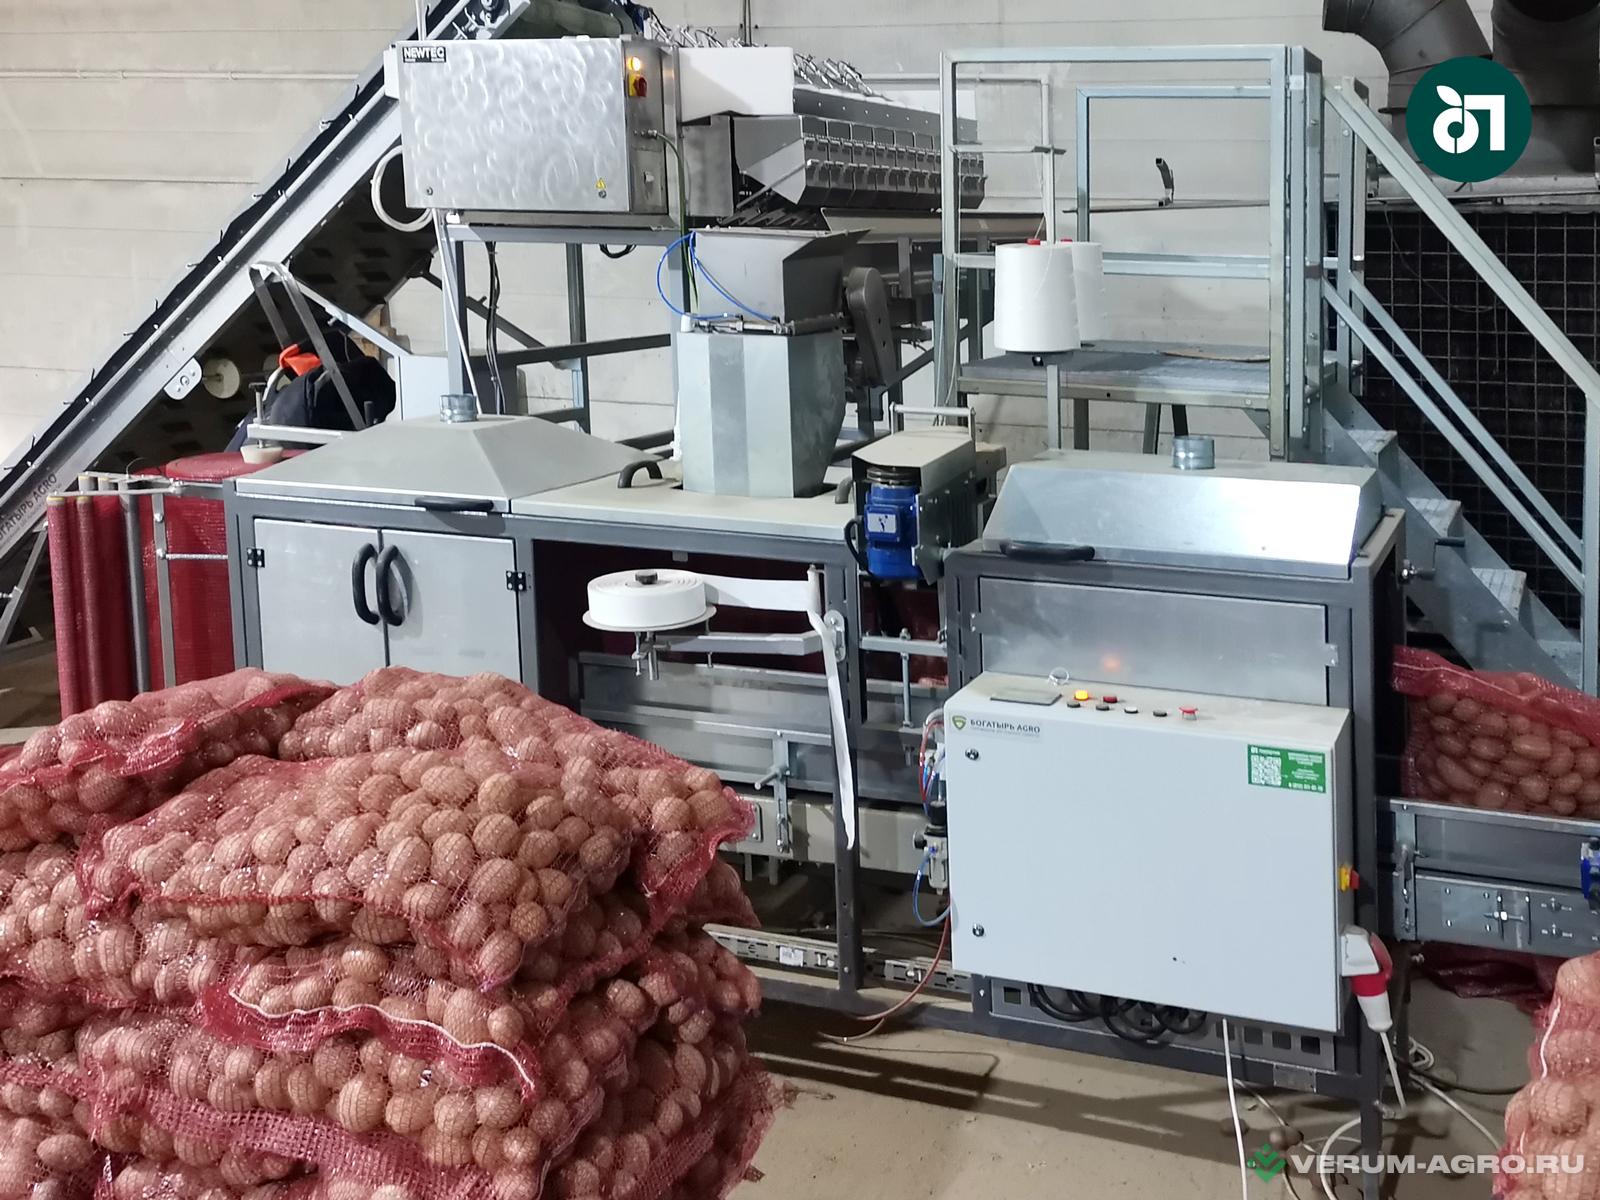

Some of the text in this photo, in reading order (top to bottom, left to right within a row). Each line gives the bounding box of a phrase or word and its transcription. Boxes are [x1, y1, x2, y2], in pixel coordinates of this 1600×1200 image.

[403, 46, 445, 59] NEWTEC
[33, 474, 57, 501] AGRO
[970, 719, 1015, 731] БОГАТЫРЬ
[1016, 724, 1041, 734] AGRO
